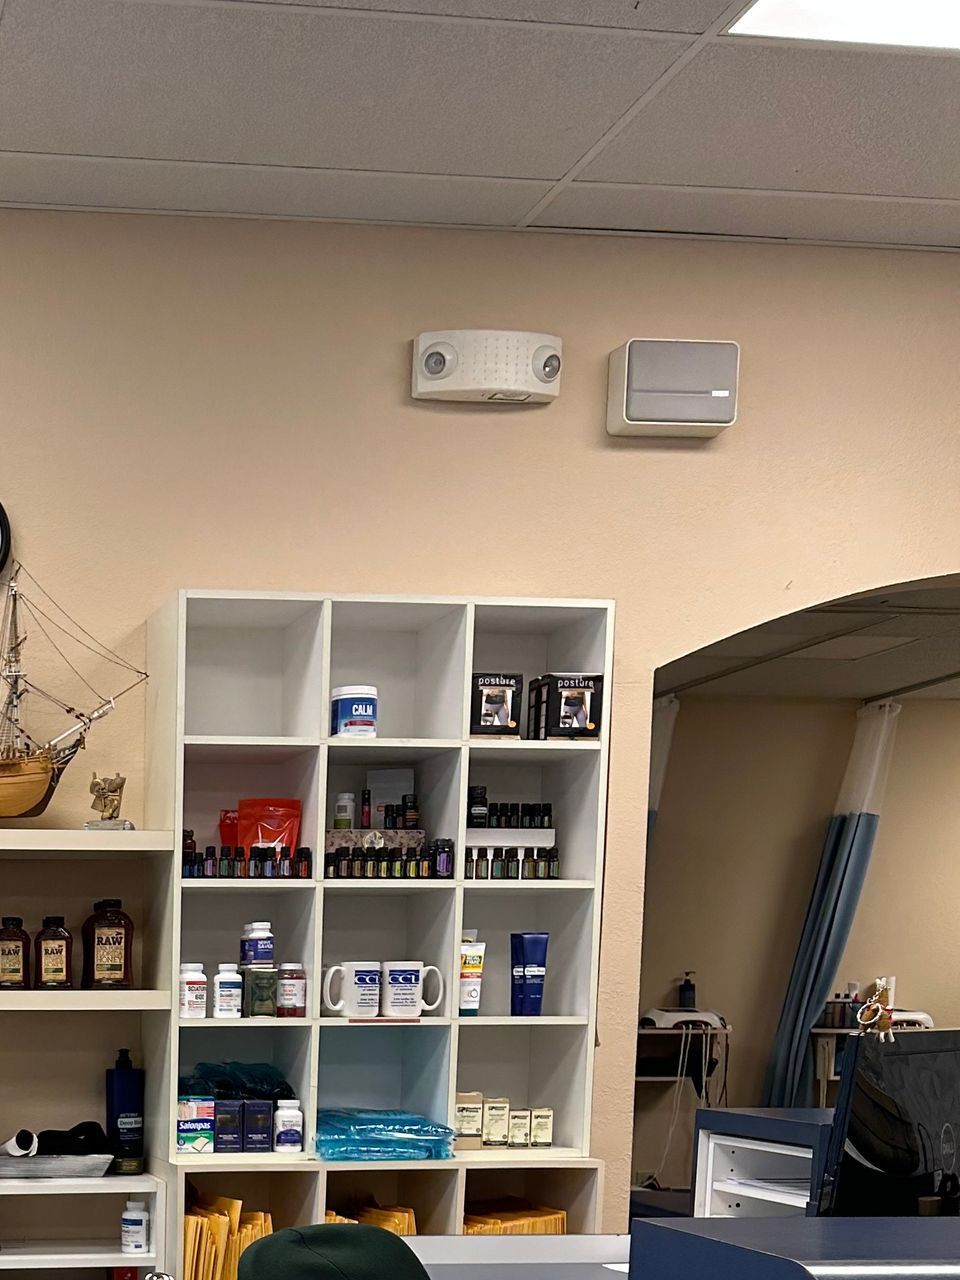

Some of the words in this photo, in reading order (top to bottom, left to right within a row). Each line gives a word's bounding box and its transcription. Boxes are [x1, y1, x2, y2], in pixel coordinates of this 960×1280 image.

[478, 676, 516, 687] posture
[557, 678, 594, 688] posture
[352, 704, 373, 716] CALM
[96, 936, 124, 946] RAW
[1, 948, 21, 956] RAW
[44, 948, 64, 956] RAW
[178, 1121, 211, 1130] Salonpas
